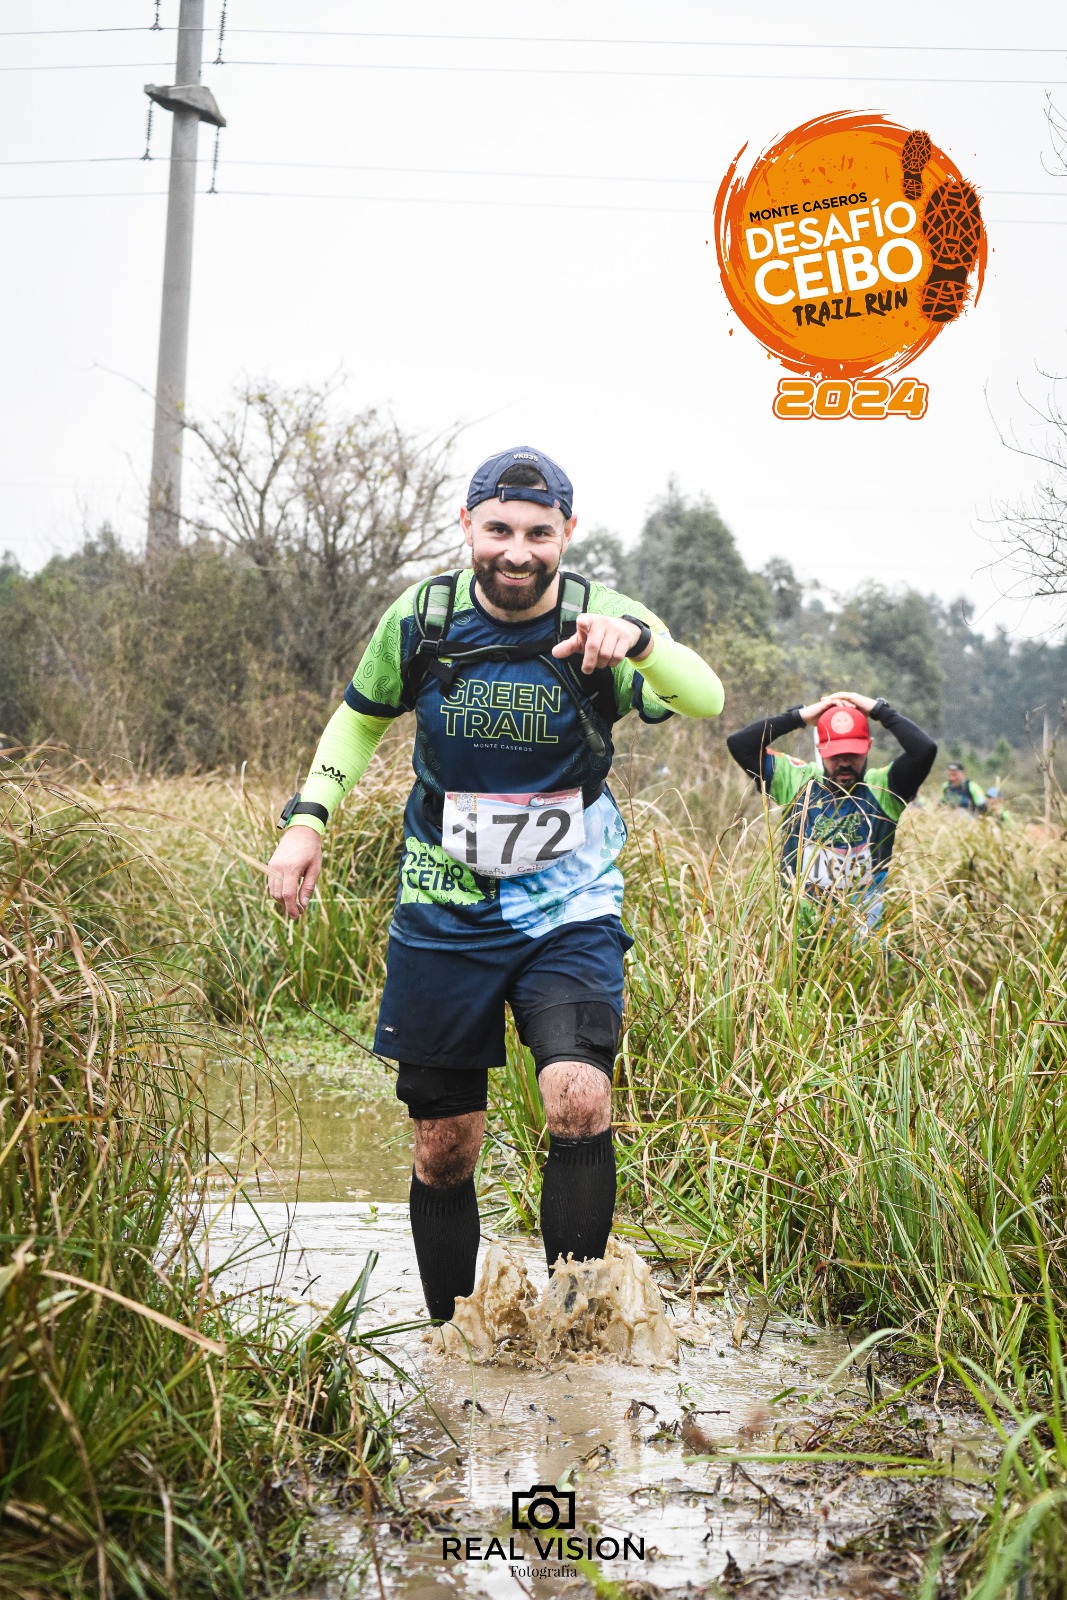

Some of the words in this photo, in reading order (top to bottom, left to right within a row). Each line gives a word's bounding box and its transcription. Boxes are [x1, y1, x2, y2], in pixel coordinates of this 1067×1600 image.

[442, 678, 561, 713] GREEN
[440, 705, 559, 744] TRAIL
[500, 744, 533, 752] CASEROS
[452, 808, 573, 864] 172
